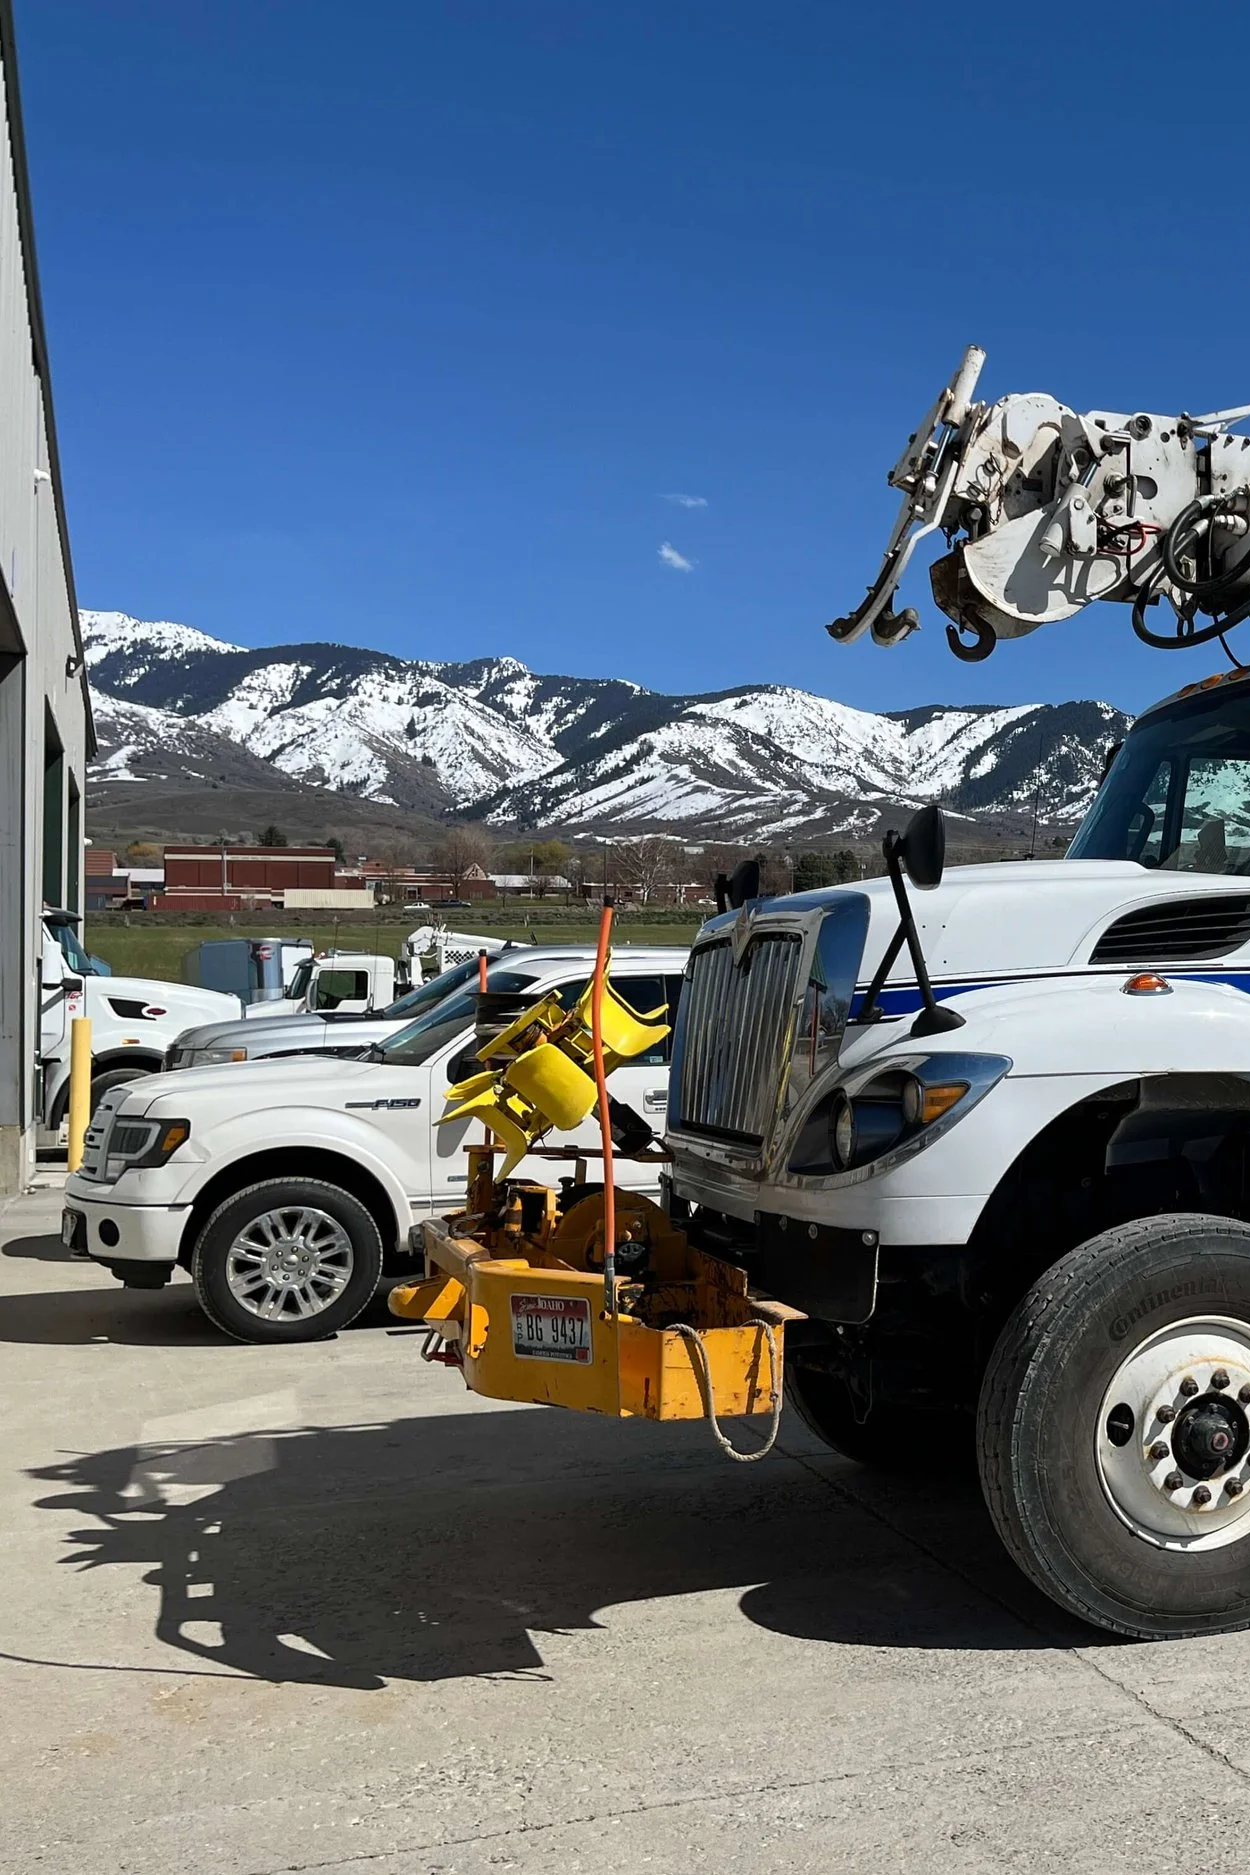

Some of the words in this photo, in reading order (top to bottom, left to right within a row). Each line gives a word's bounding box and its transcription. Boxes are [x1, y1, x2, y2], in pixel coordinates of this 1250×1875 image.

[537, 1296, 565, 1312] IDAHO
[526, 1313, 543, 1342] BG
[551, 1315, 584, 1346] 9437
